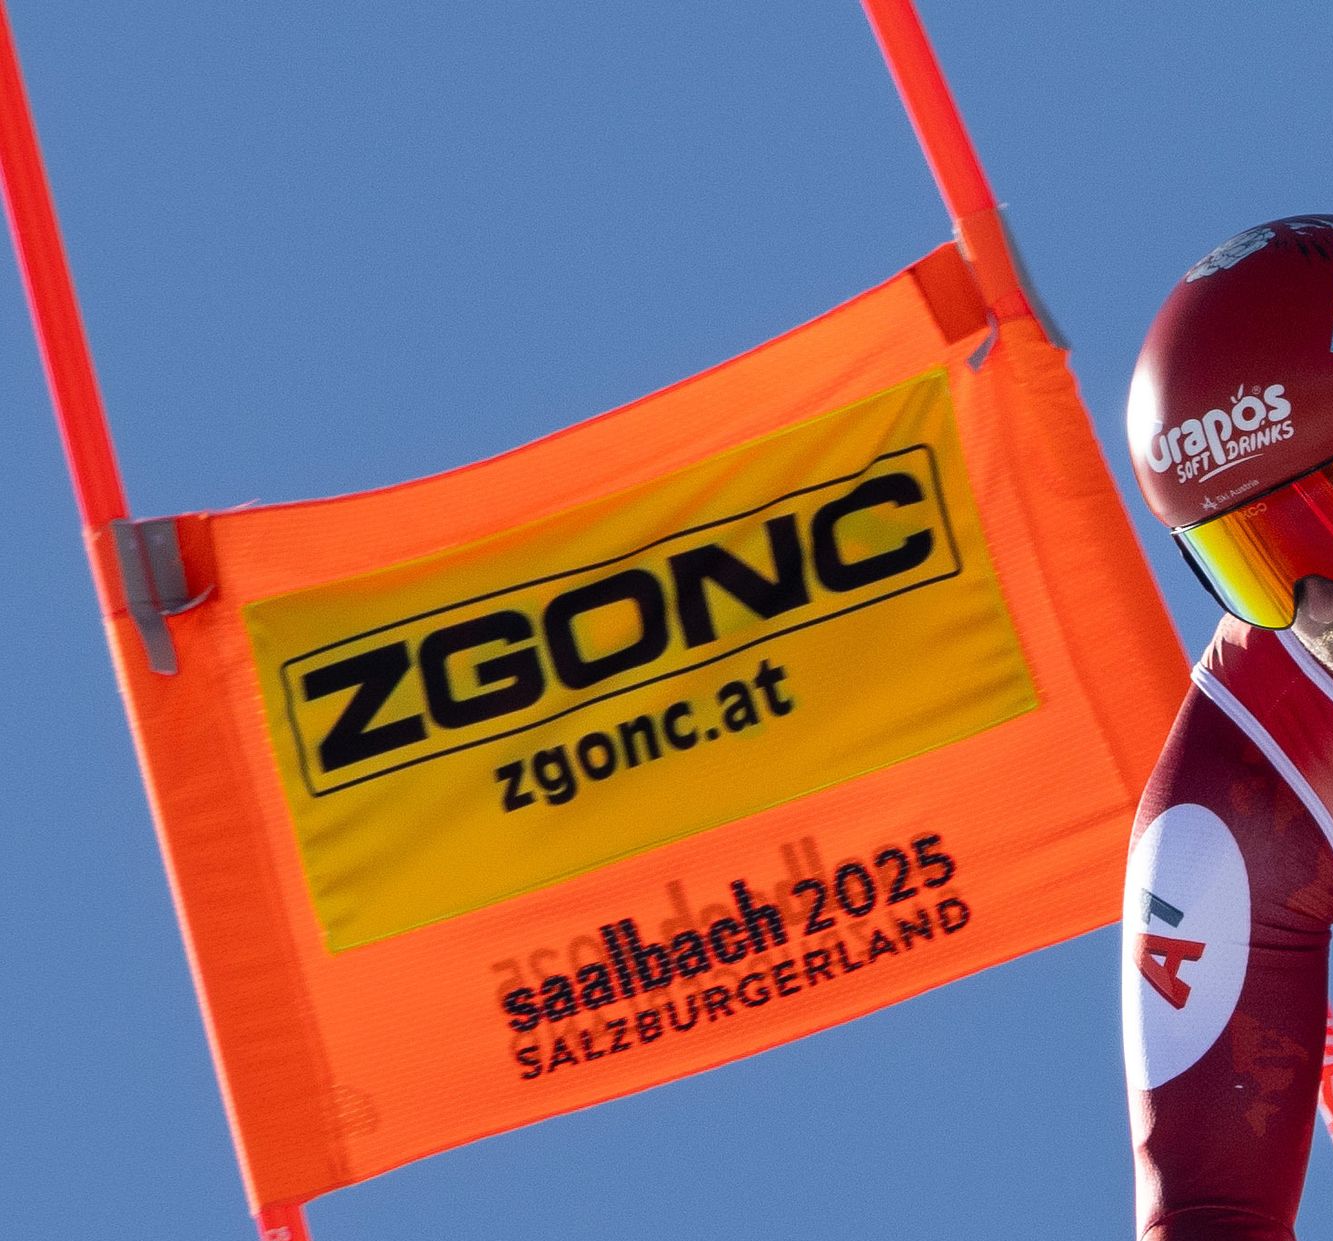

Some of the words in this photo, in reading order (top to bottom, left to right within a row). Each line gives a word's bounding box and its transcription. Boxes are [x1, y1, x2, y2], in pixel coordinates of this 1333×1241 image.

[1176, 451, 1211, 484] SOFT
[1226, 420, 1295, 460] DRINKS
[303, 472, 935, 774] ZGONC
[494, 659, 796, 814] zgonc.at
[501, 879, 789, 1033] saalbach
[793, 833, 957, 937] 2025
[514, 896, 972, 1081] SALZBURGERLAND
